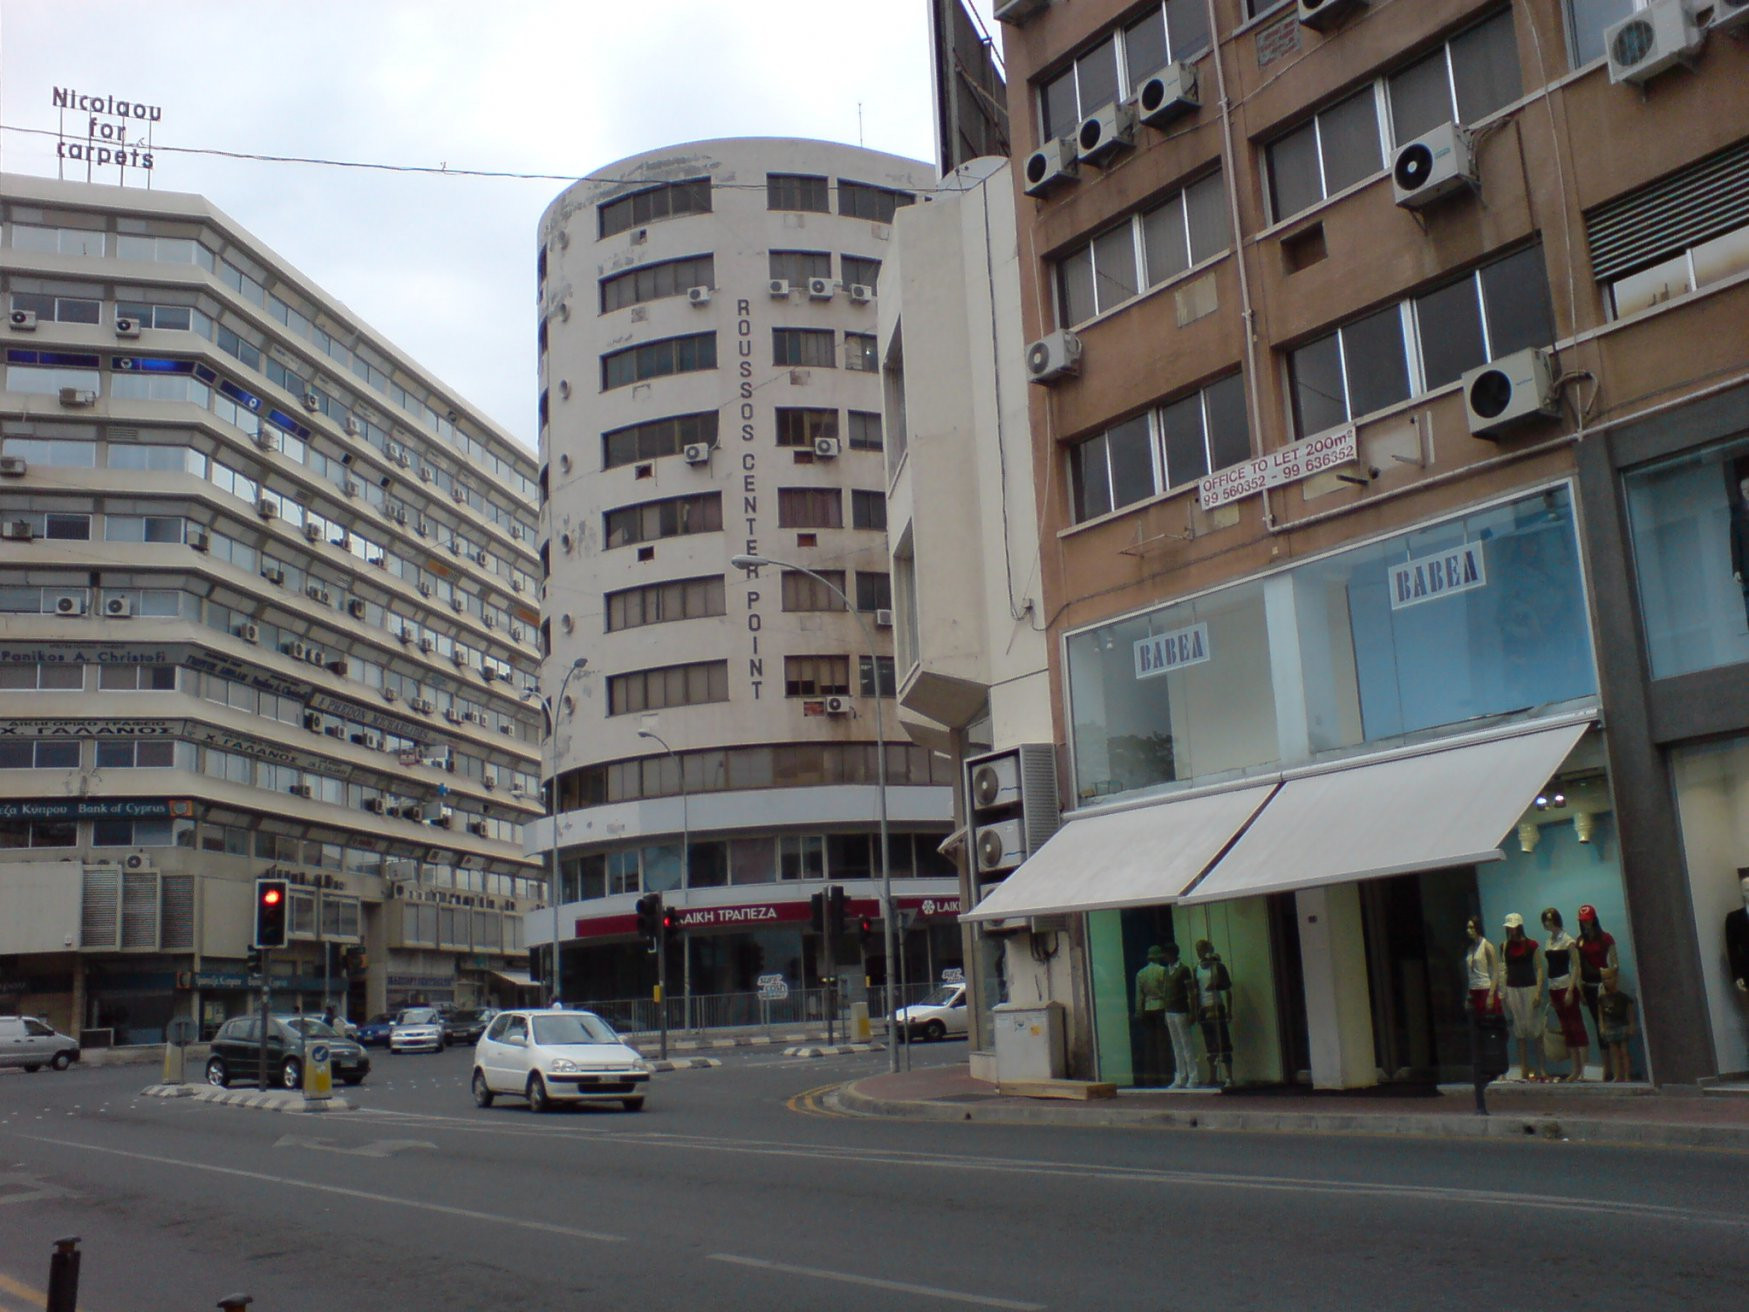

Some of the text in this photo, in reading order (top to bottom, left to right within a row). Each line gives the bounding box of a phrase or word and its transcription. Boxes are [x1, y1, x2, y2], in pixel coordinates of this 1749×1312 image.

[52, 86, 161, 121] Nicolaou
[89, 117, 126, 141] for
[57, 142, 154, 169] carpets
[1203, 467, 1246, 492] OFFICE
[1251, 459, 1268, 474] TO
[1273, 447, 1300, 467] LET
[1203, 492, 1219, 507] 99
[1223, 475, 1266, 501] 560352
[1283, 463, 1300, 479] 99
[1305, 445, 1354, 472] 636352
[737, 299, 763, 701] ROUSSOS CENTER POINT
[98, 650, 166, 663] Christofi
[78, 803, 166, 817] Bank of Cyprus
[718, 907, 777, 922] ΤΡΑΠΕΖΑ
